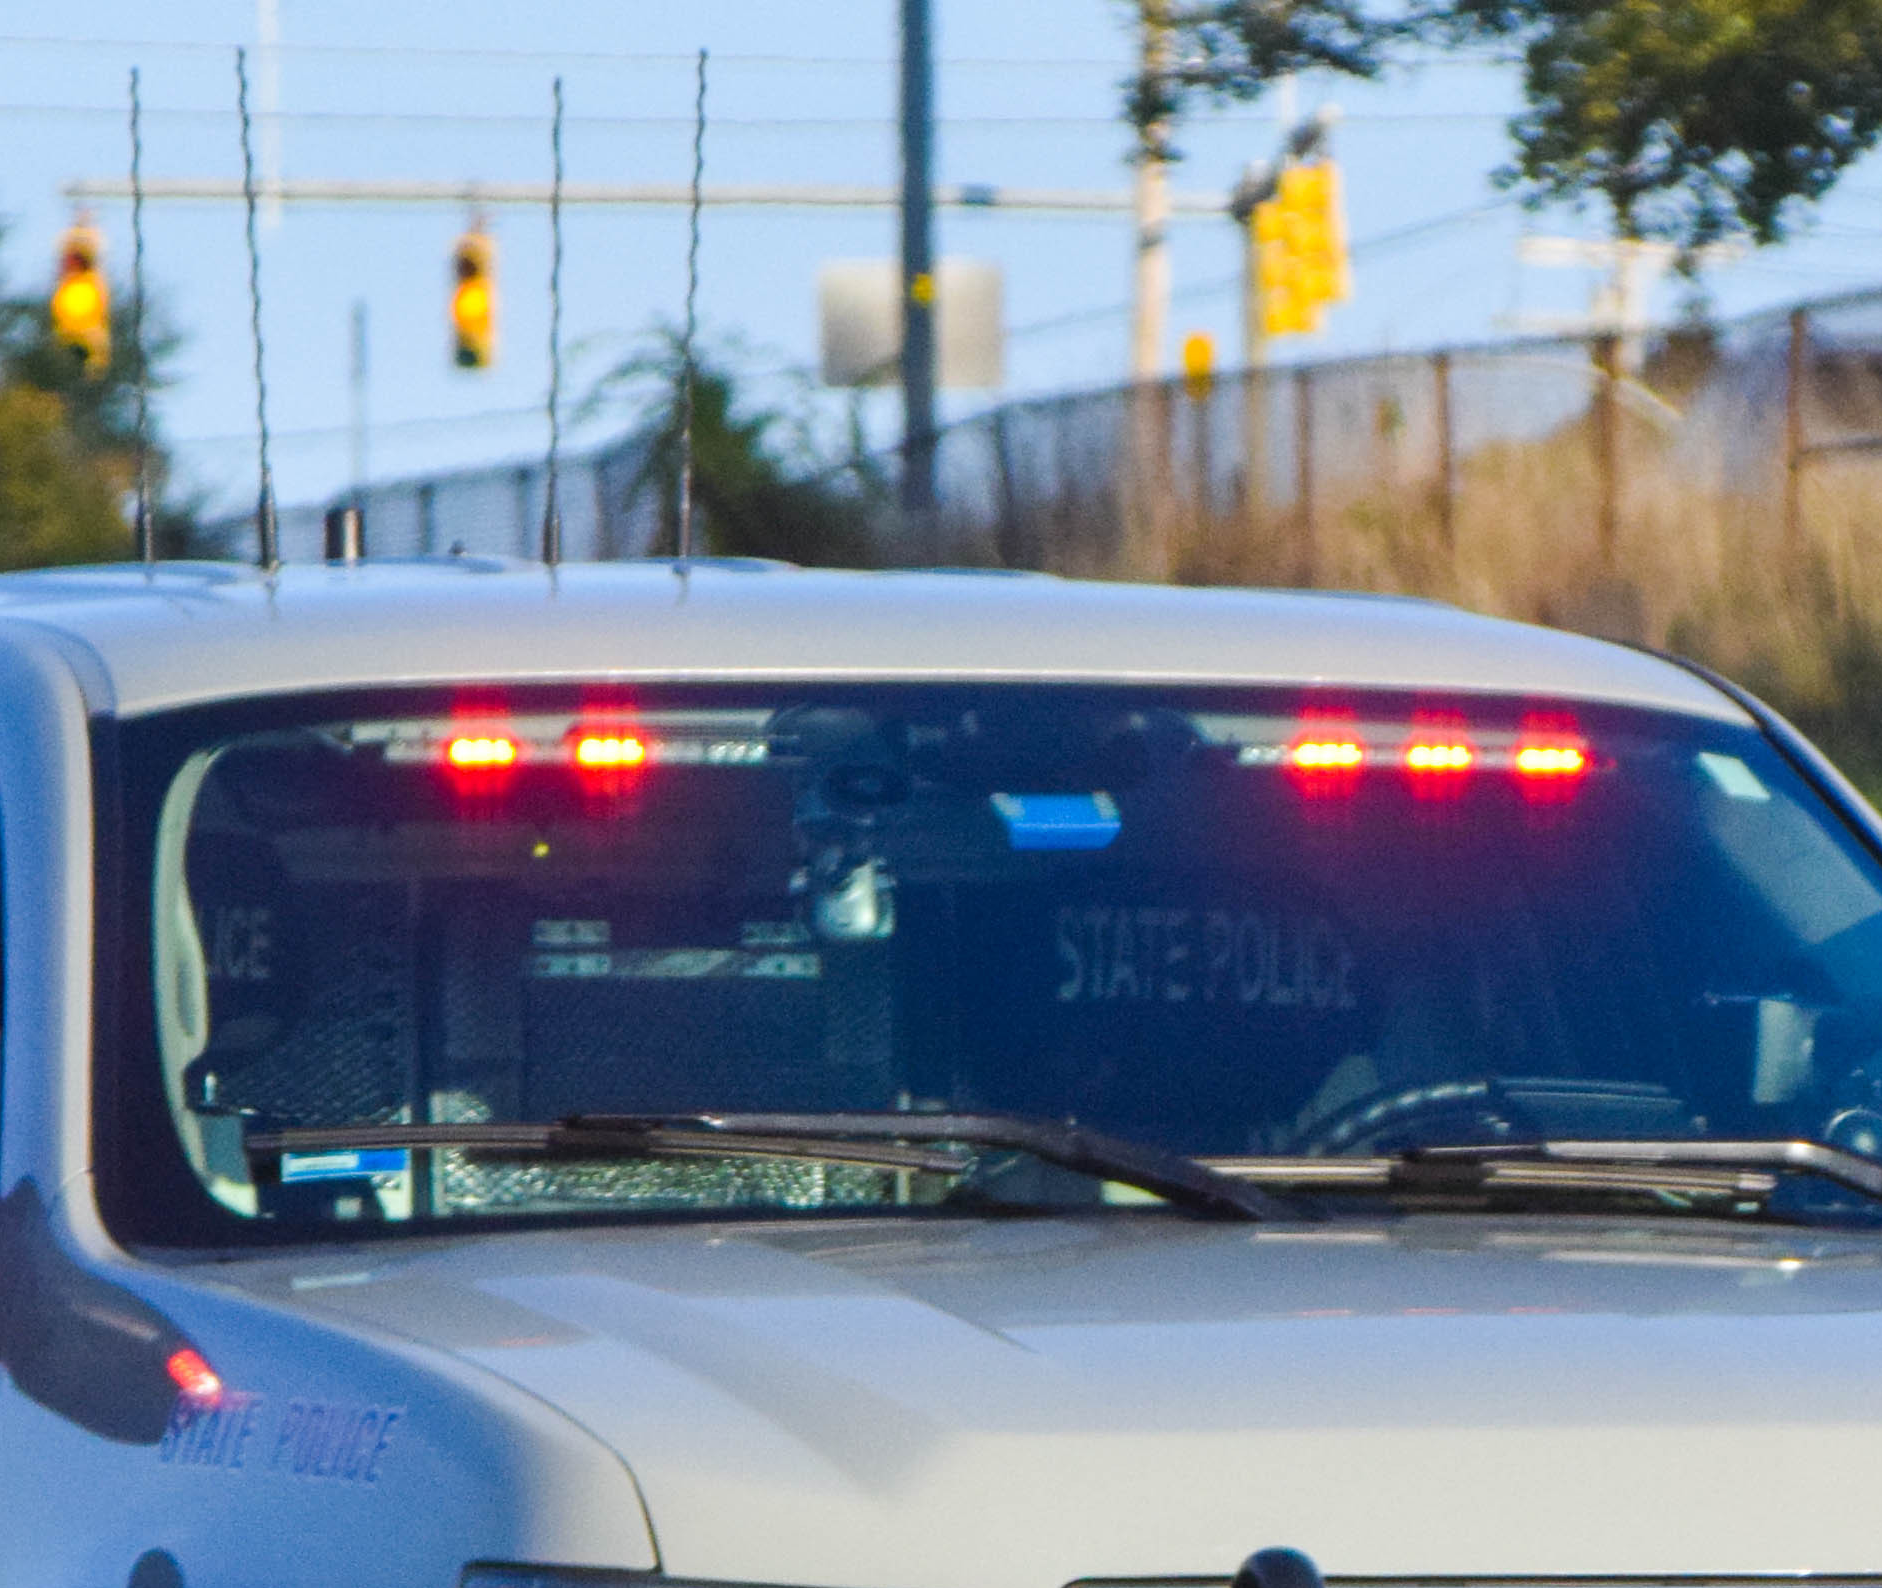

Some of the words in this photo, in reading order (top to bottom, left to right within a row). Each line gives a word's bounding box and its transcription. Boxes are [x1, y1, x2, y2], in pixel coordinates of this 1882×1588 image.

[1055, 904, 1192, 1003] STATE
[158, 1391, 265, 1468] STATE
[269, 1402, 403, 1484] POLICE
